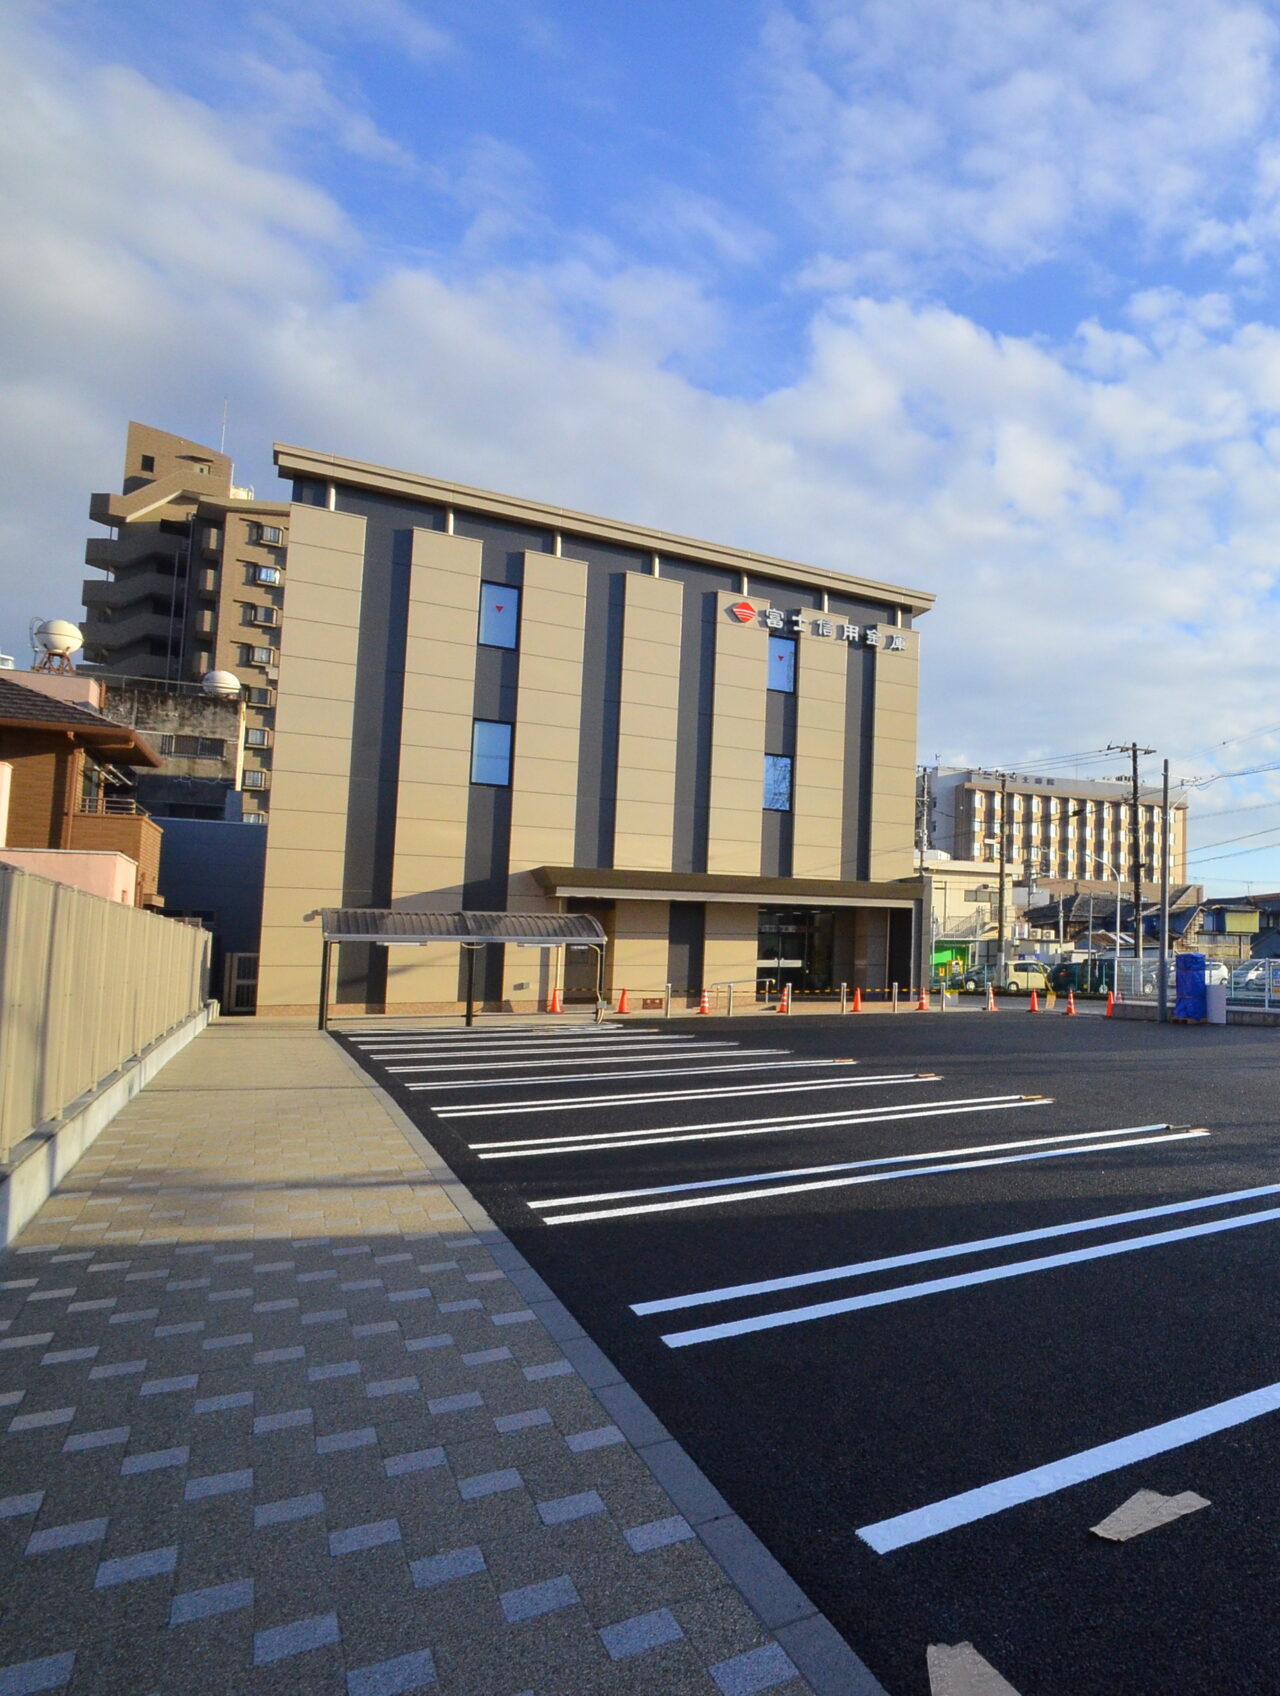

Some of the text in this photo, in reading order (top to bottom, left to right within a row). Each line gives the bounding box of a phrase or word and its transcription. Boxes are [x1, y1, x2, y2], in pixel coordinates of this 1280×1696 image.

[766, 607, 907, 650] 富士信用金庫
